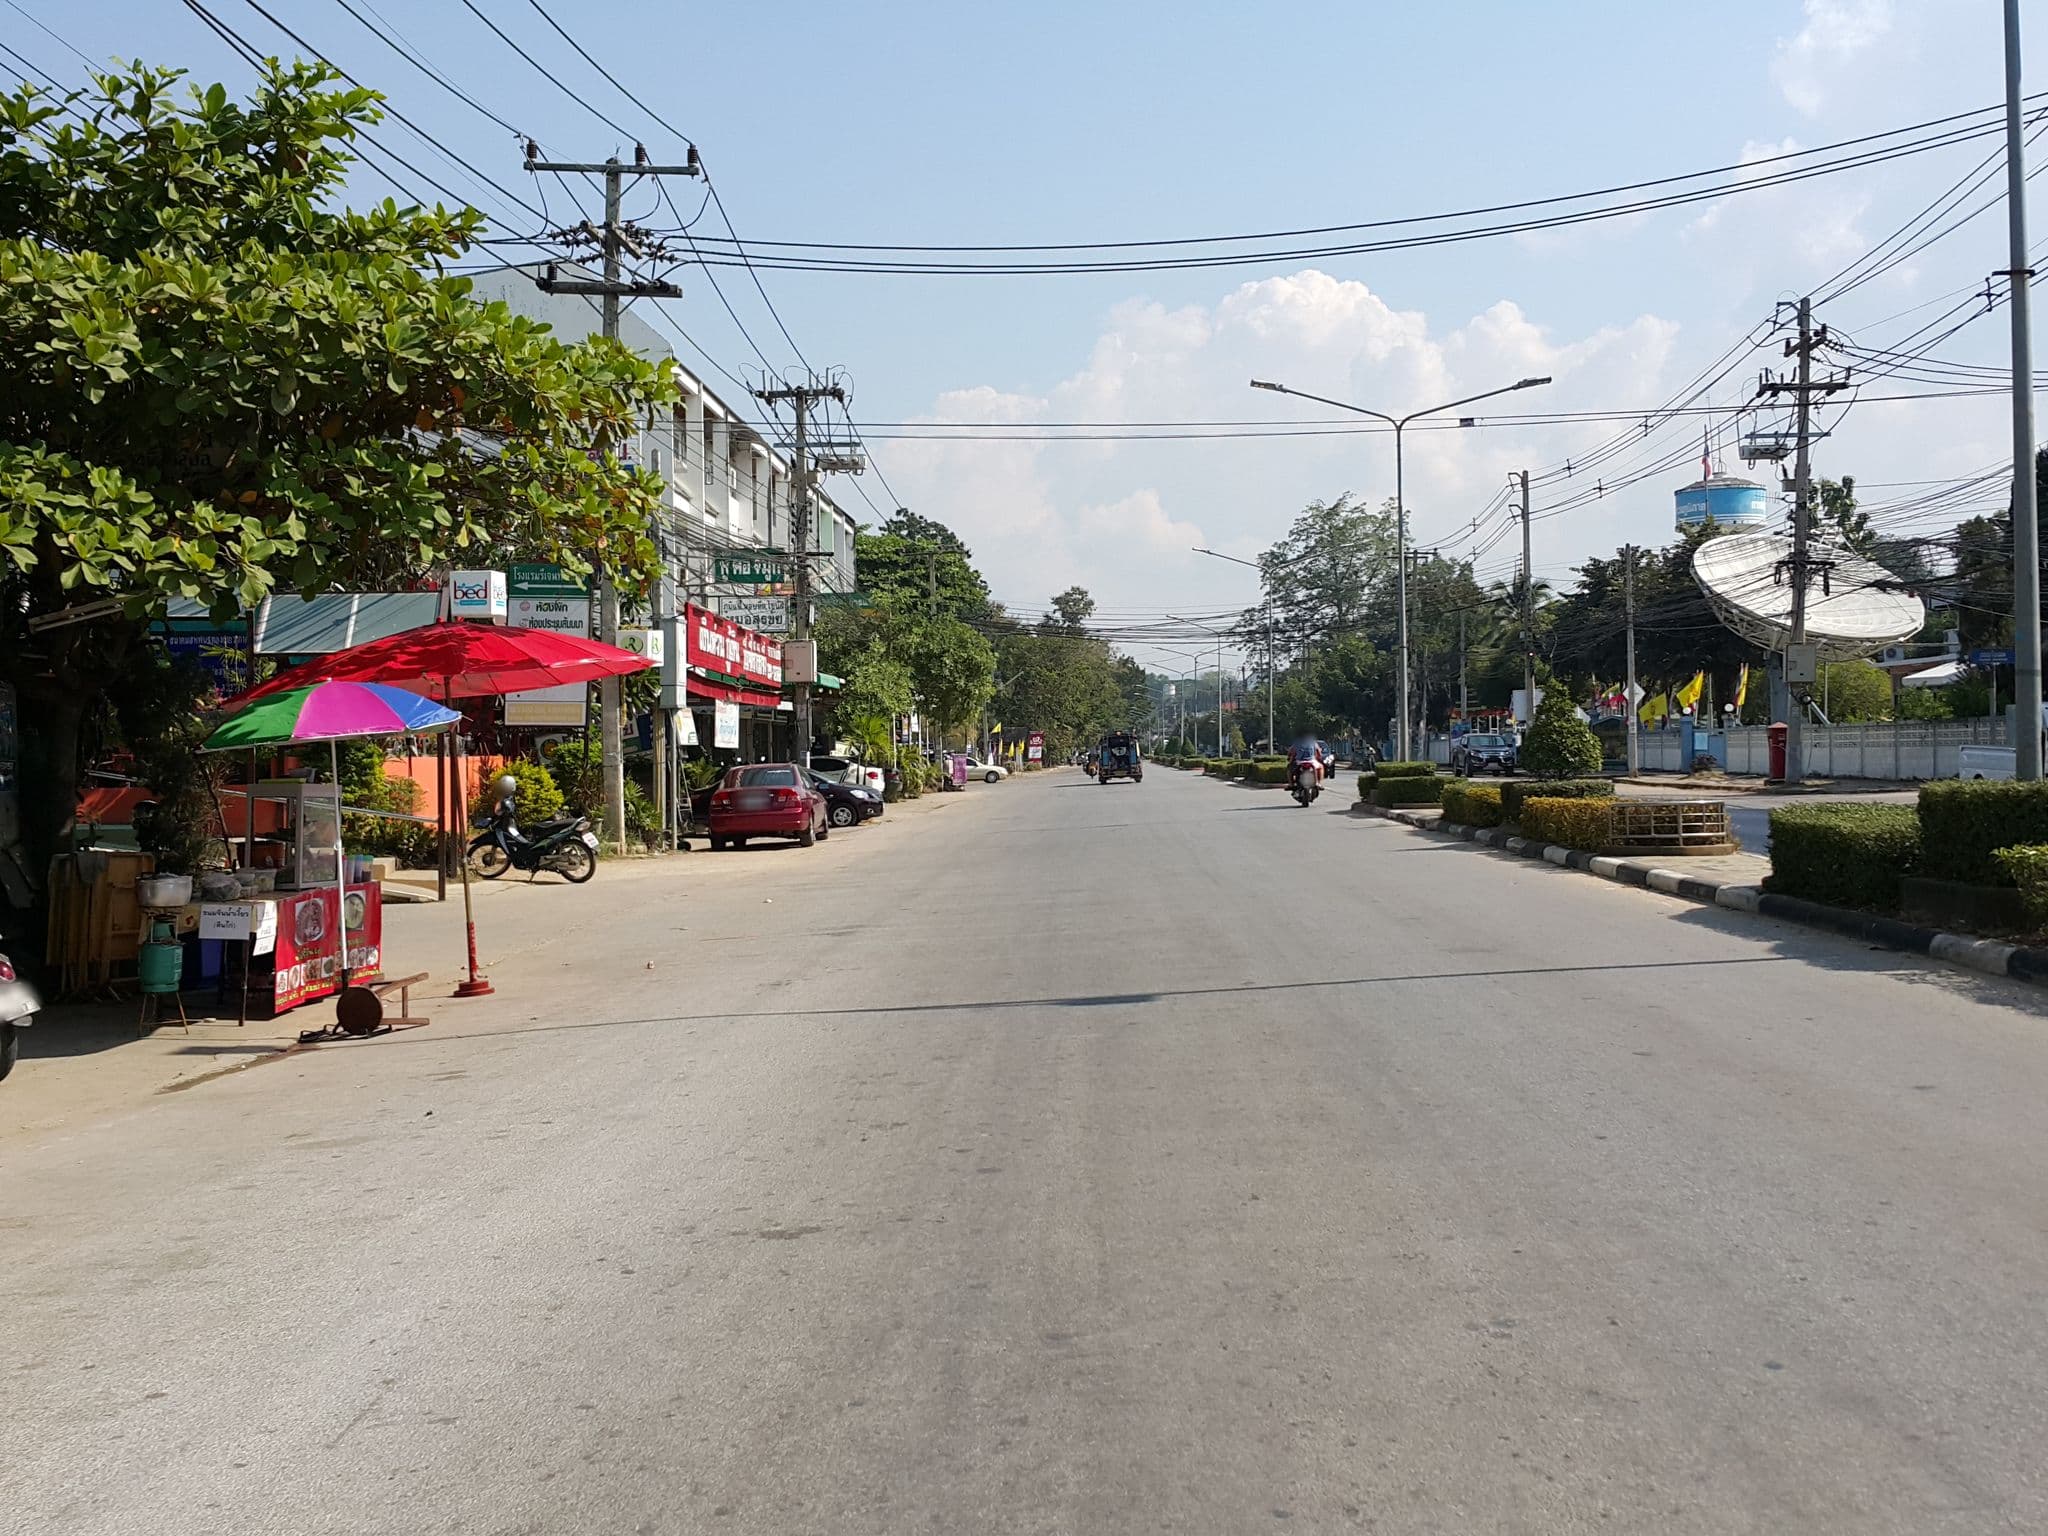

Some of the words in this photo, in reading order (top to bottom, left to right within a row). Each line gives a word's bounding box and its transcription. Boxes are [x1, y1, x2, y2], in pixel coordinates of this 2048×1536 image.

[733, 561, 751, 575] คอ
[454, 580, 487, 599] bed
[528, 617, 583, 631] ห้องประชุมสัมมนา
